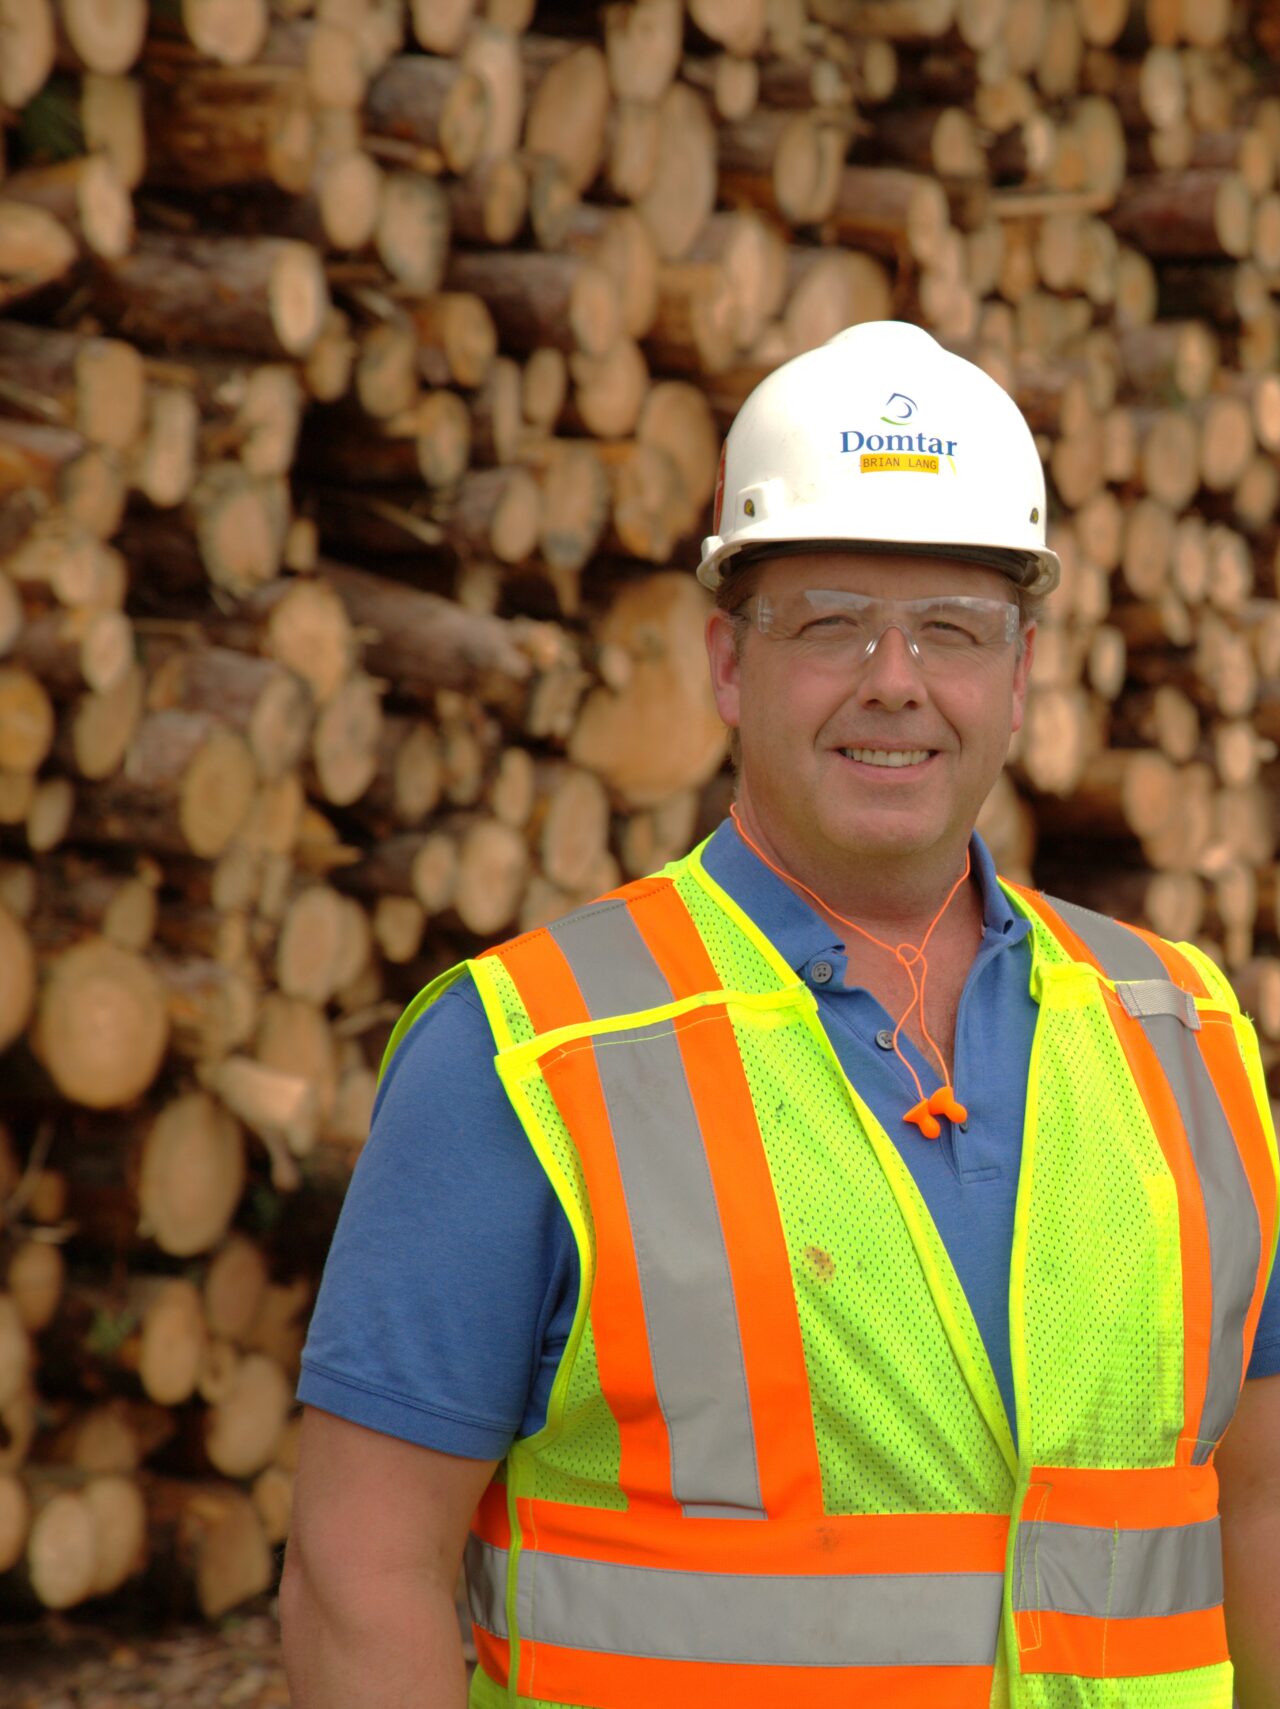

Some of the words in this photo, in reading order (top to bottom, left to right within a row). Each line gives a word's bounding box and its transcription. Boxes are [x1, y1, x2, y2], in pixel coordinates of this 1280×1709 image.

[840, 430, 957, 457] Domtar
[863, 456, 900, 468] BRIAN
[908, 458, 937, 470] LANG
